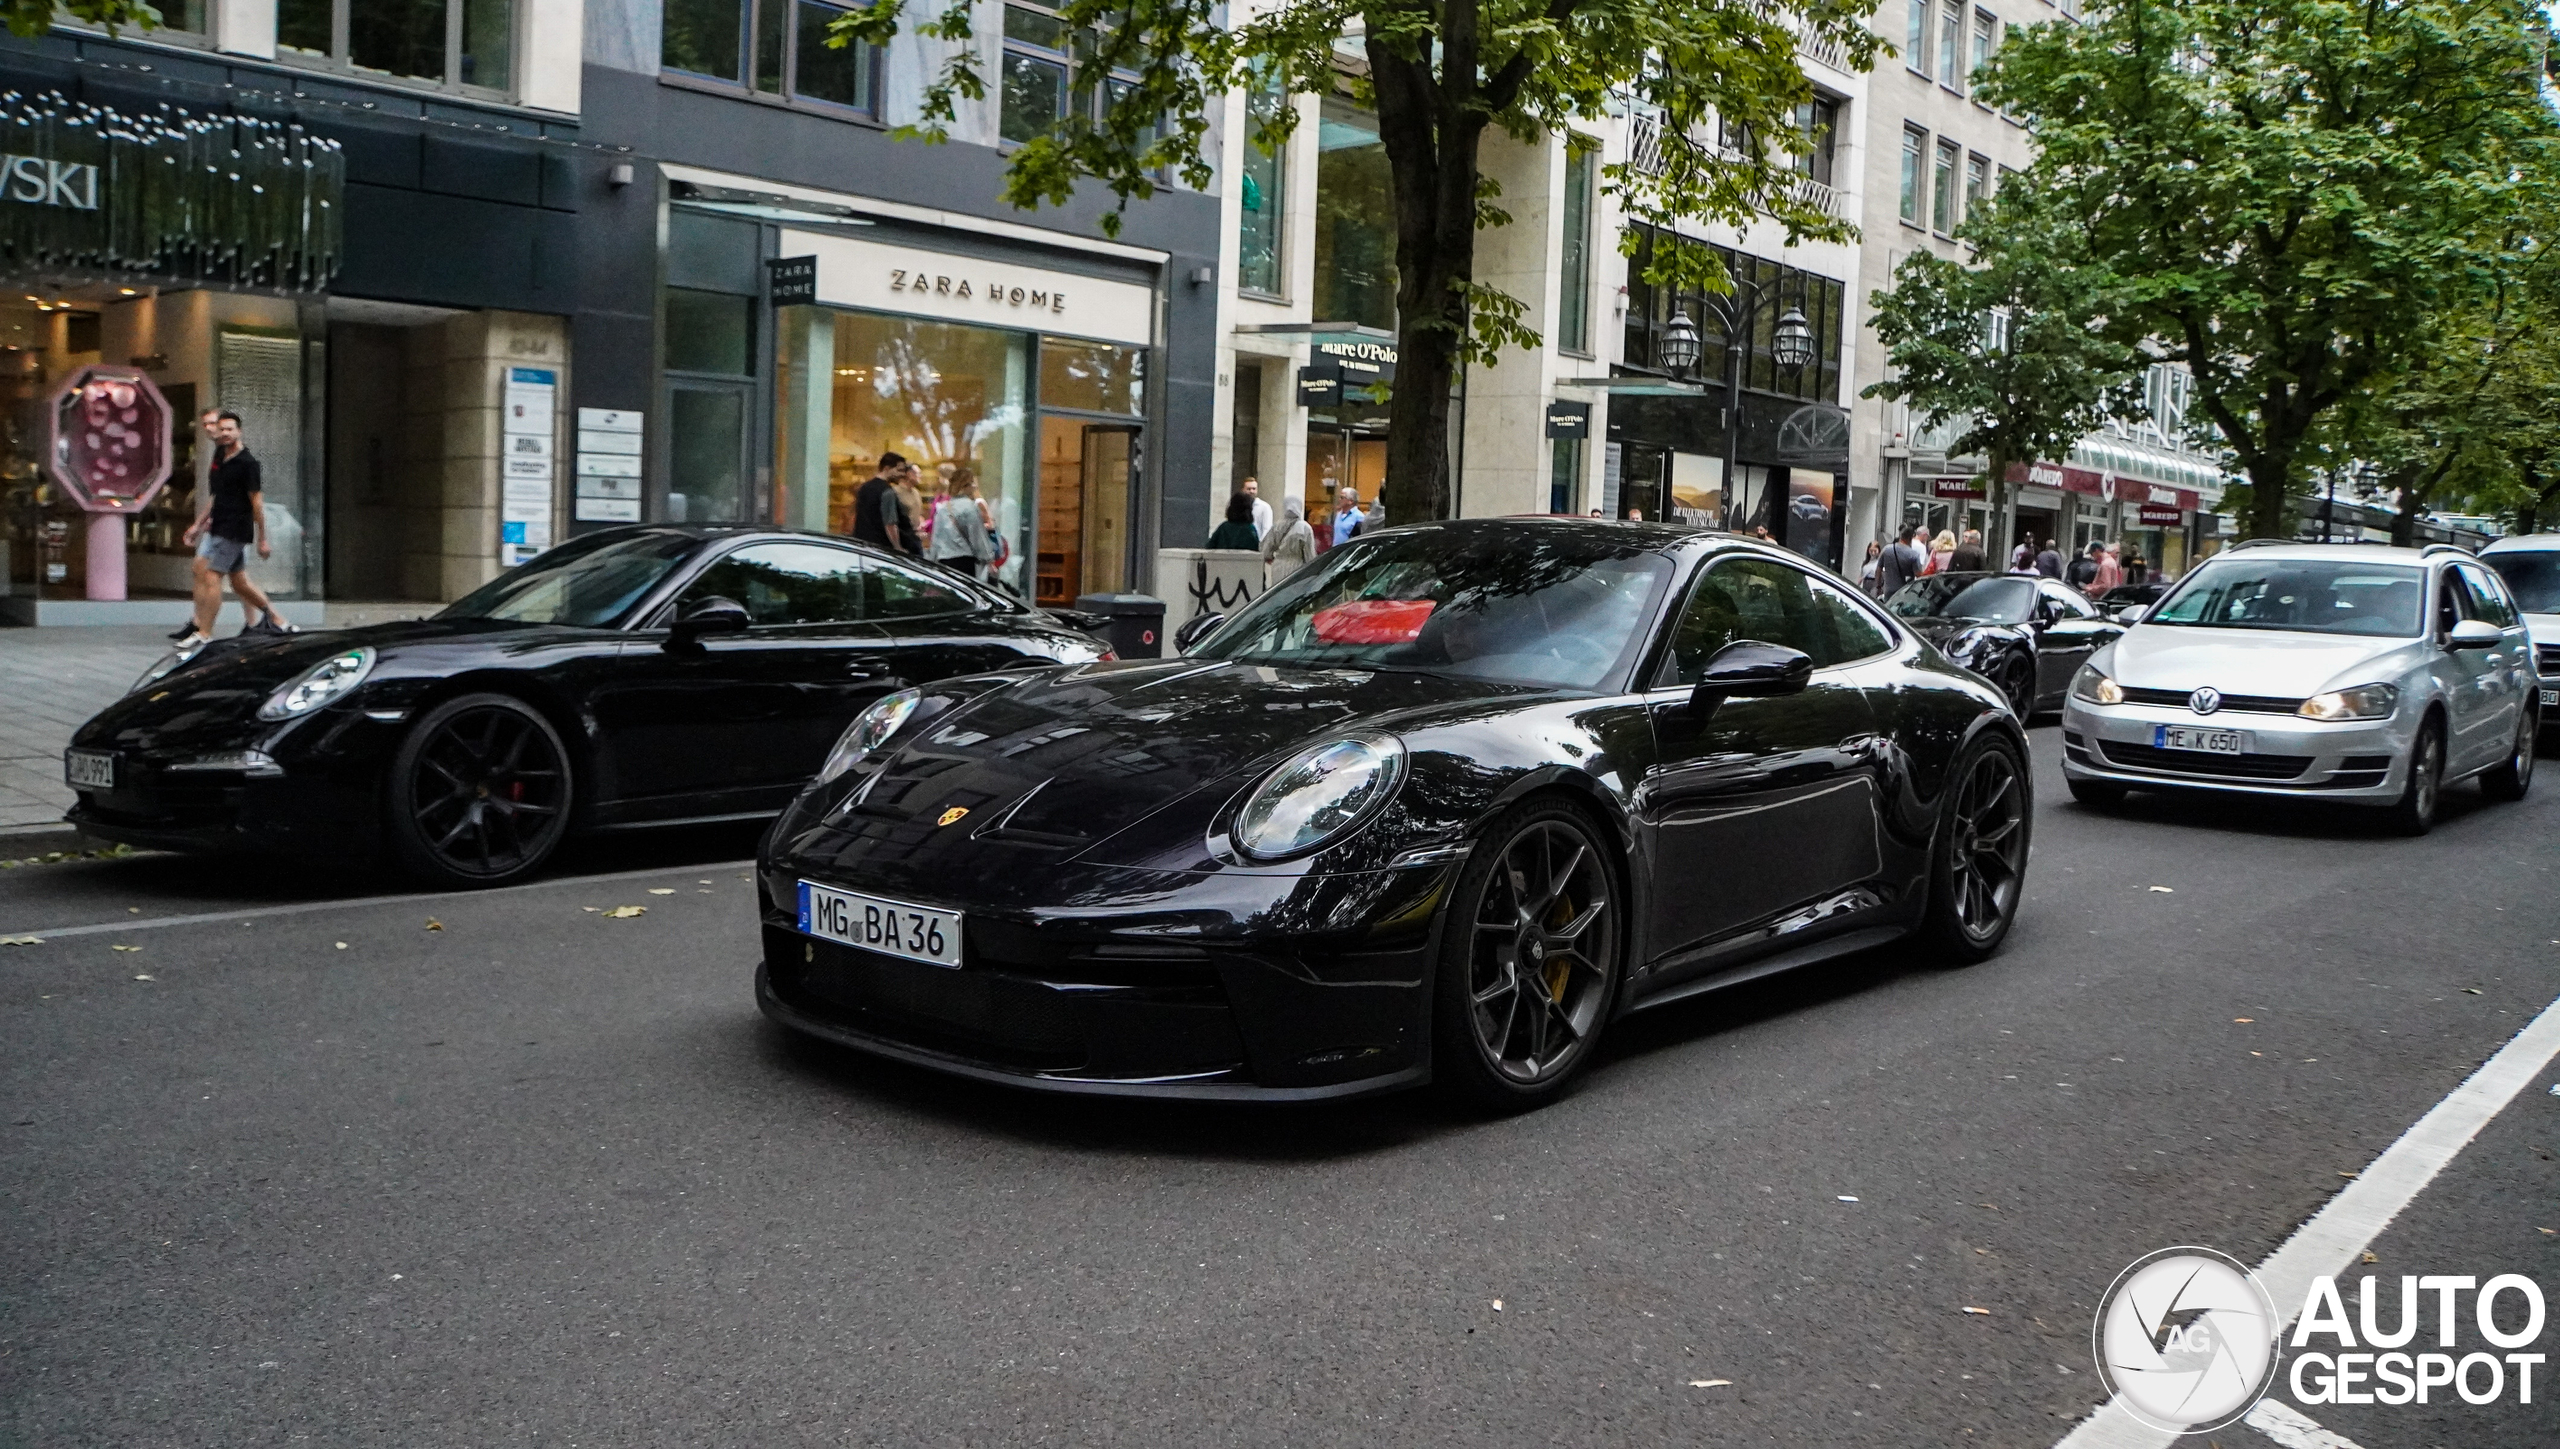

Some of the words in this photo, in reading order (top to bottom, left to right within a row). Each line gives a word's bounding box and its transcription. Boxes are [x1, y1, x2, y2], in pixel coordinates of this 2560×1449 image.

[776, 265, 813, 280] ZARA
[773, 283, 813, 297] HOME
[891, 268, 972, 298] ZARA
[988, 283, 1065, 314] HOME
[1321, 343, 1356, 358] Marc
[1357, 343, 1398, 364] O'Polo
[2029, 465, 2064, 487] MAREDO
[2142, 511, 2179, 521] MAREDO
[2166, 730, 2186, 748] ME
[2195, 732, 2206, 750] K
[2209, 733, 2238, 752] 650
[817, 893, 848, 937] MG
[865, 904, 901, 951] BA
[908, 912, 944, 957] 36
